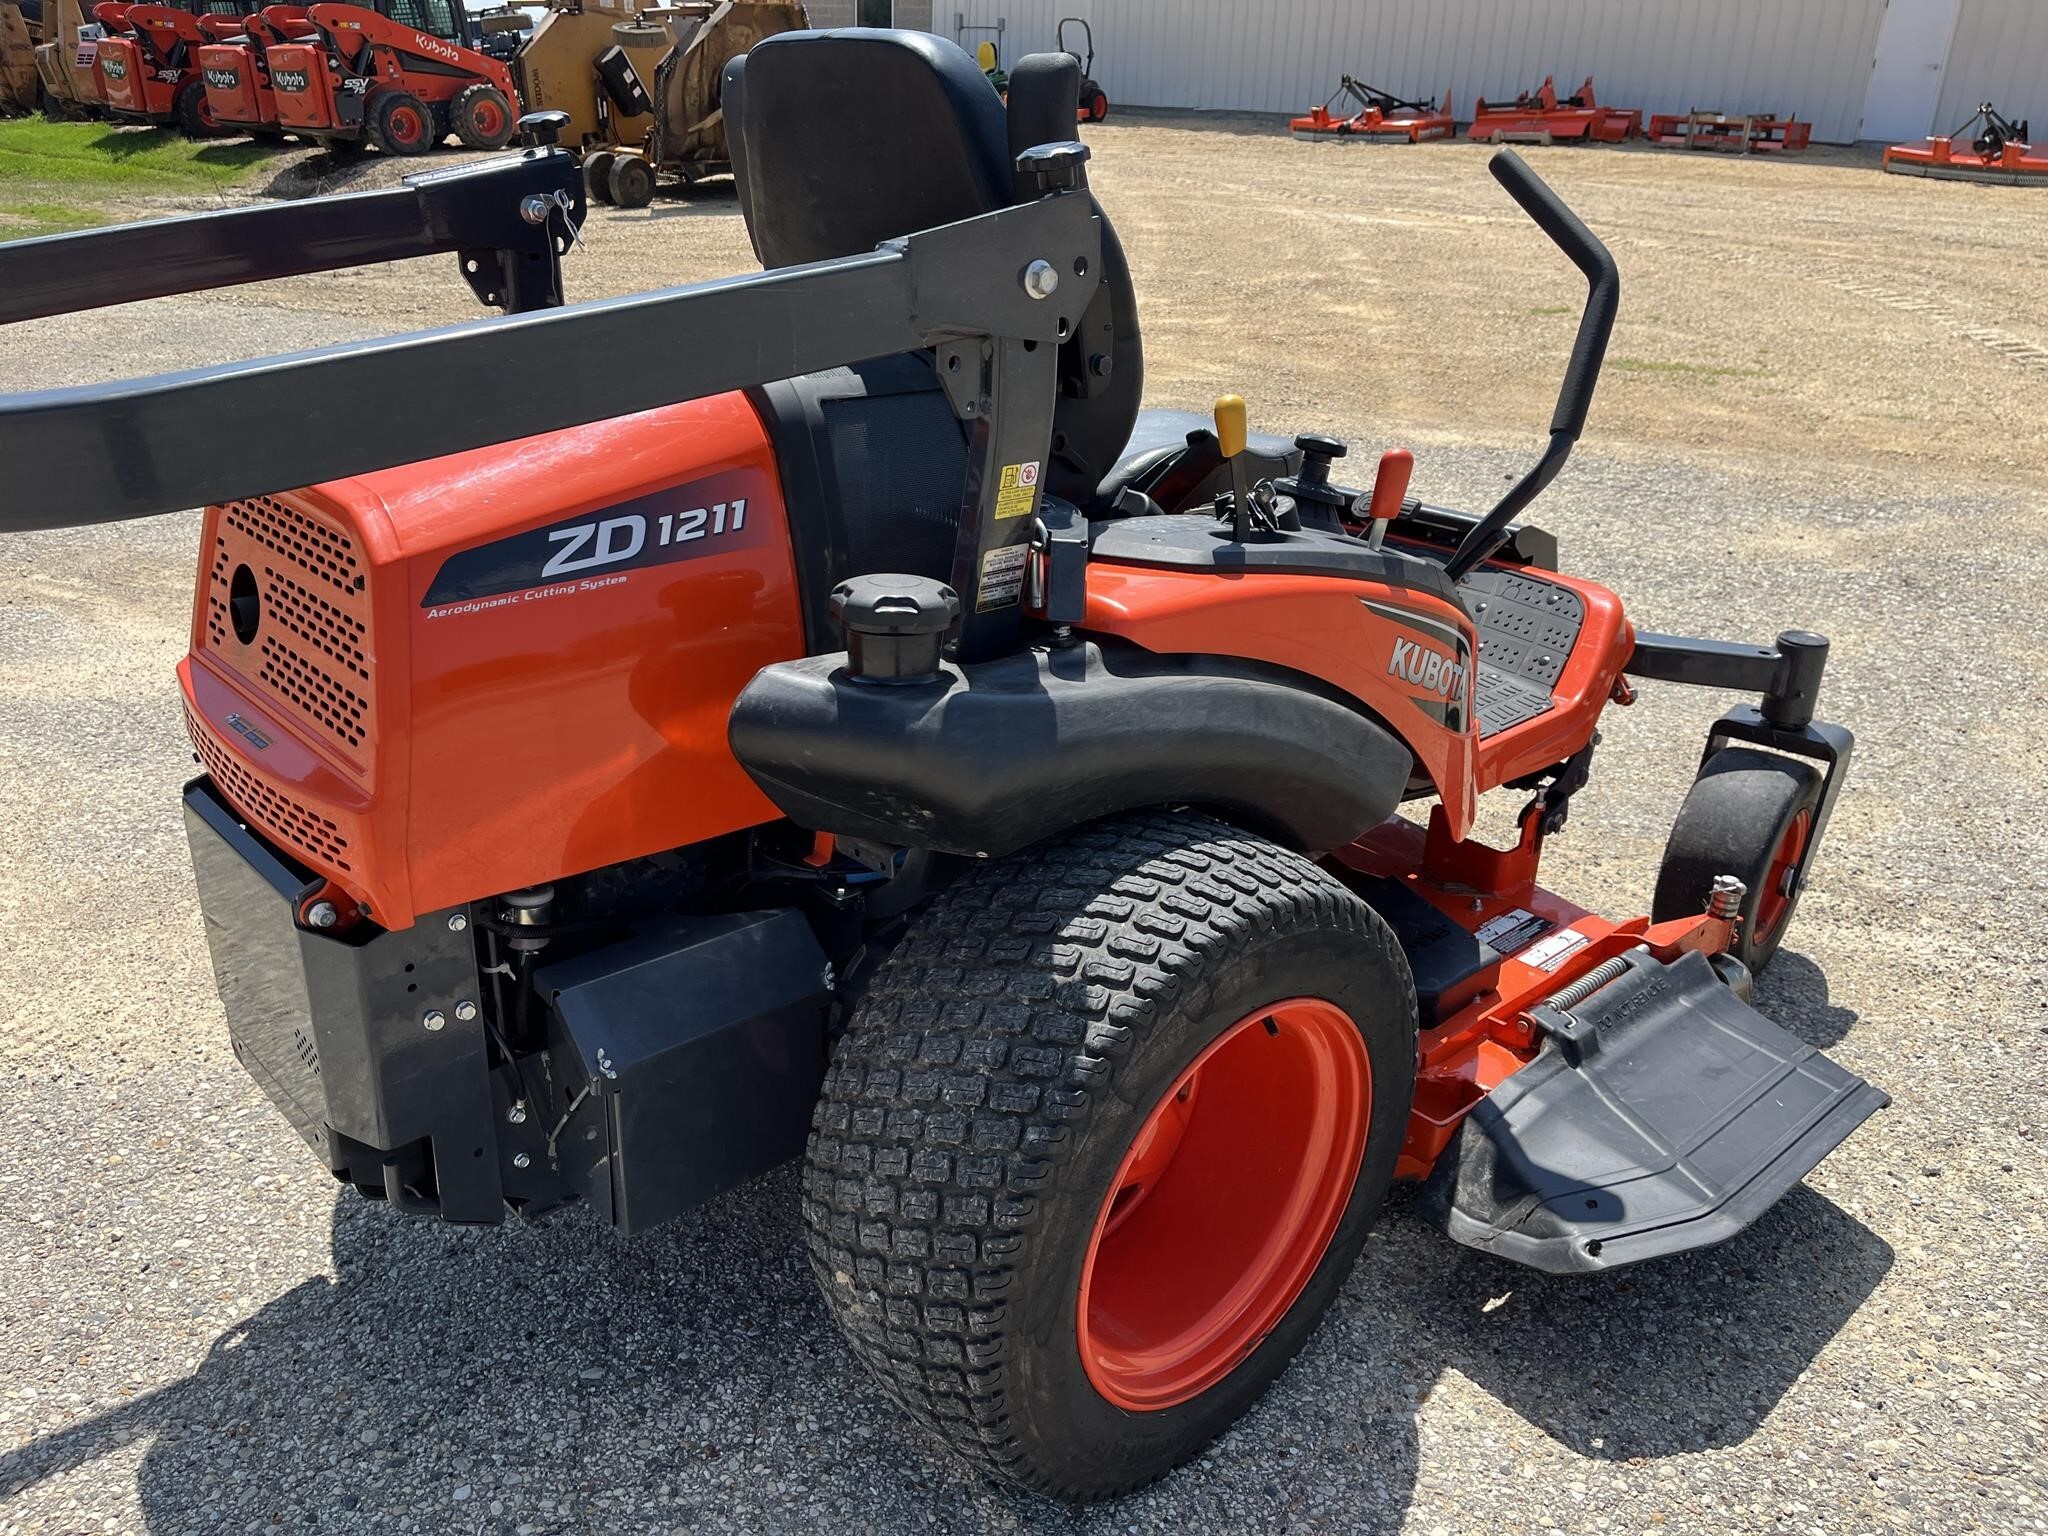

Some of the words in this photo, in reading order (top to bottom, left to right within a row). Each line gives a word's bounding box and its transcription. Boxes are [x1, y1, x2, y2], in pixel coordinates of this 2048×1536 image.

[415, 34, 459, 61] Kubota
[157, 69, 182, 79] SSV
[207, 70, 236, 84] Kubota
[275, 72, 305, 86] Kubota
[344, 78, 369, 88] SSV
[541, 513, 647, 578] ZD
[658, 498, 748, 547] 1211
[427, 594, 519, 619] Aerodynamic
[524, 584, 576, 601] Cutting
[580, 575, 627, 592] System
[1387, 636, 1467, 700] KUBOTA
[1597, 1015, 1613, 1032] DO
[1615, 1000, 1633, 1020] NOT
